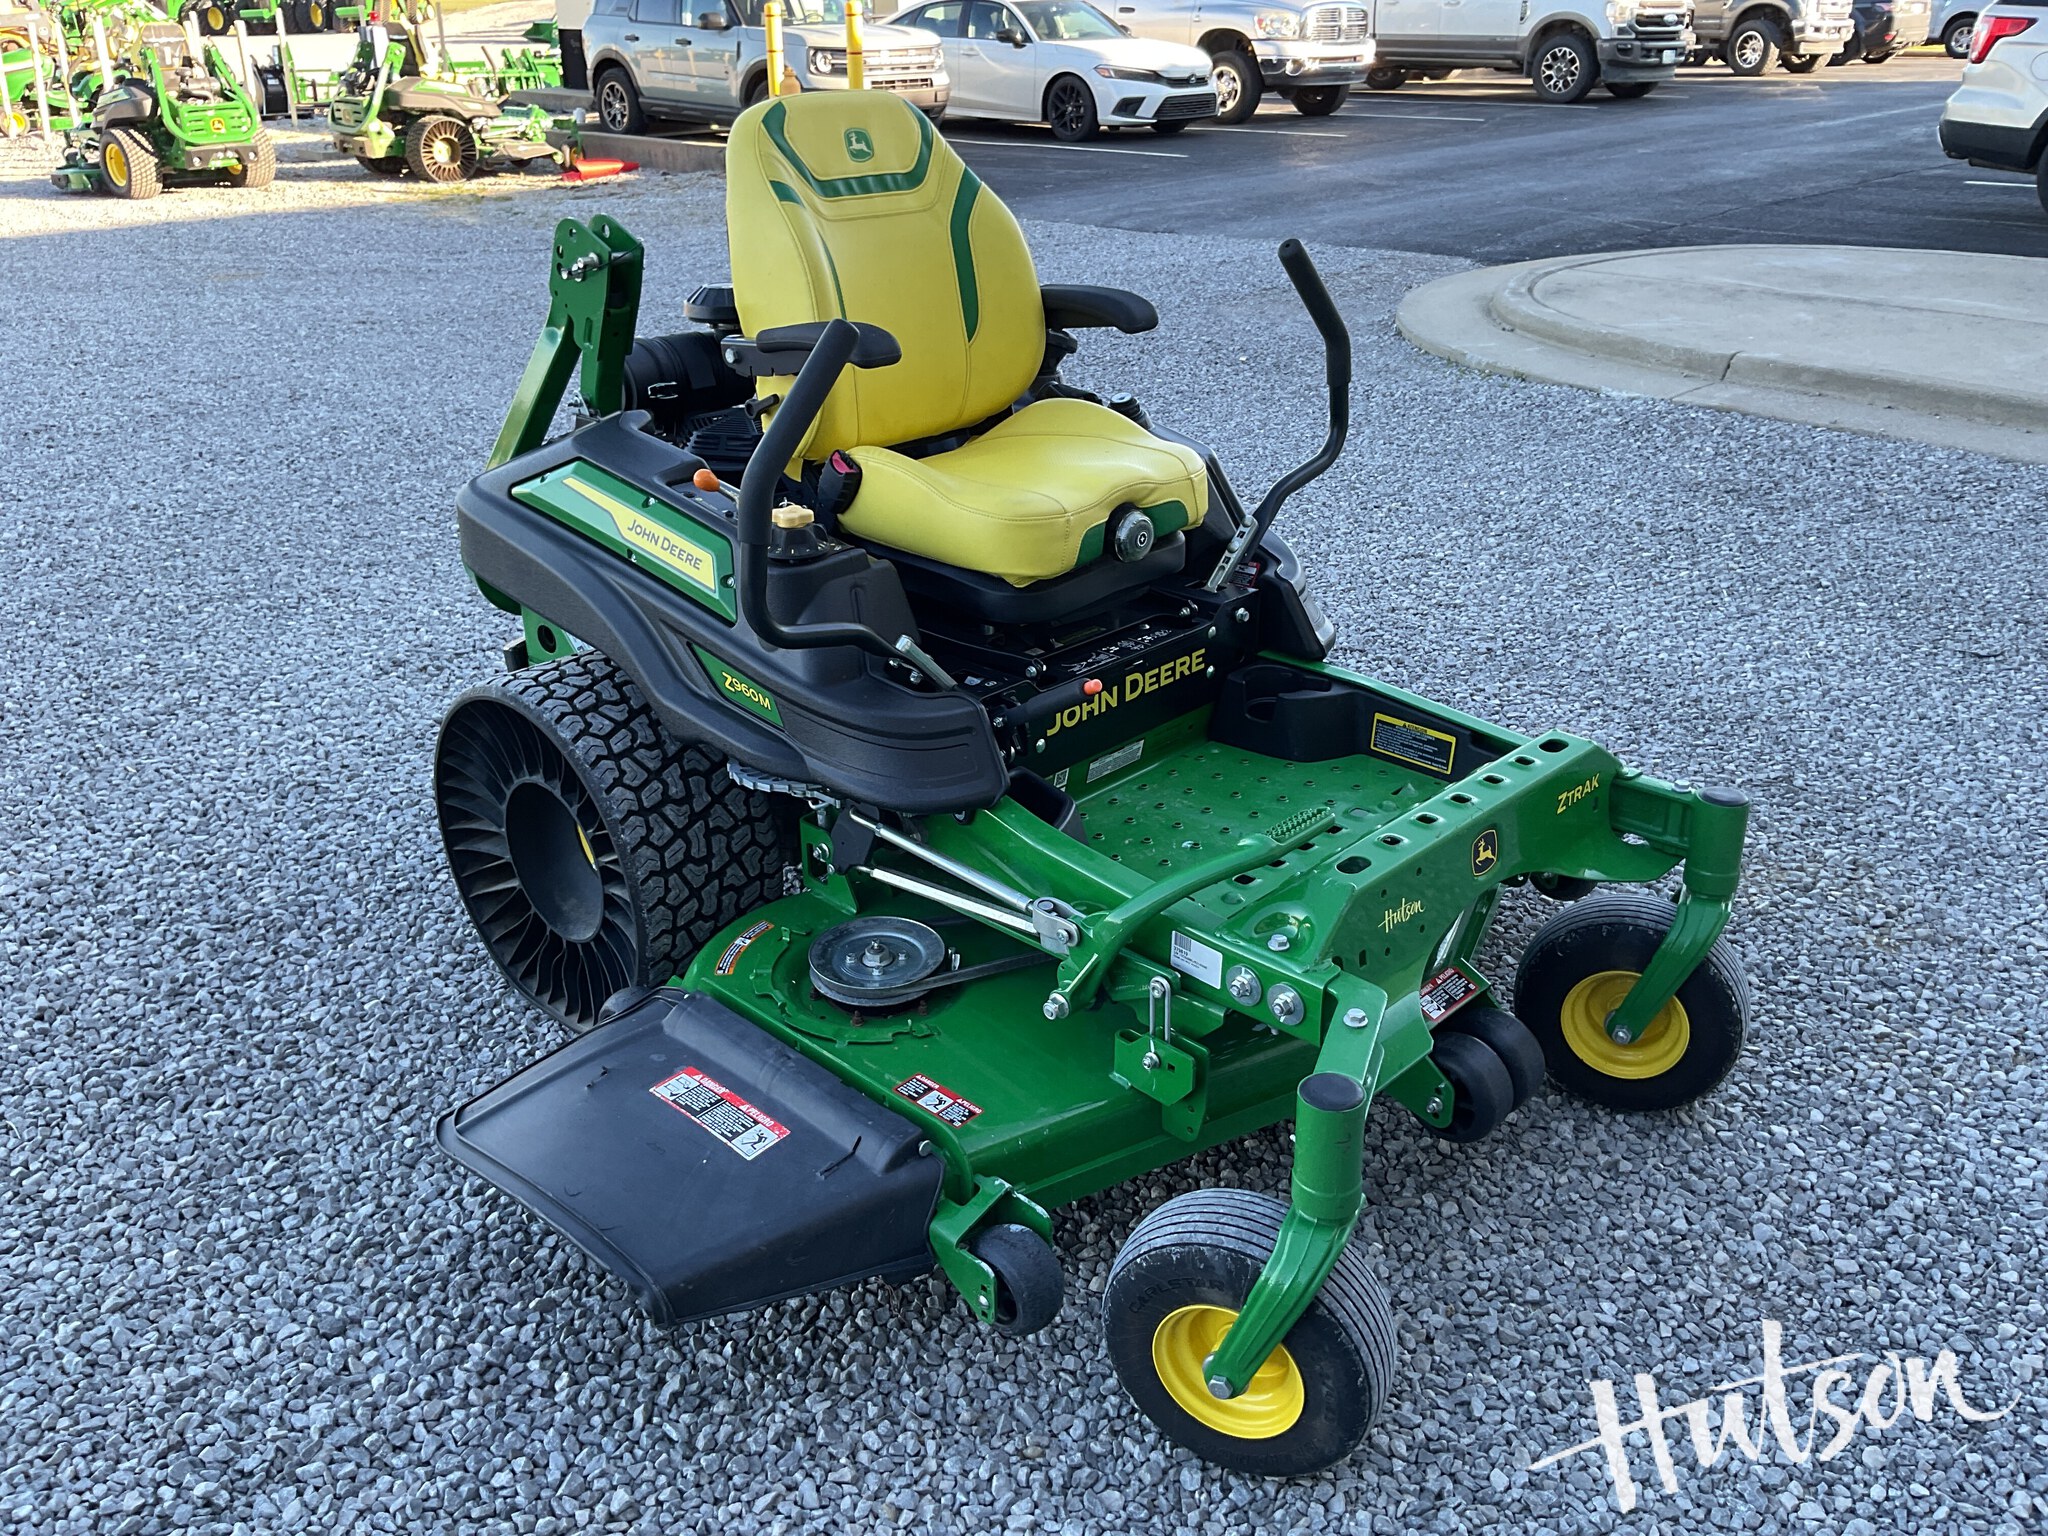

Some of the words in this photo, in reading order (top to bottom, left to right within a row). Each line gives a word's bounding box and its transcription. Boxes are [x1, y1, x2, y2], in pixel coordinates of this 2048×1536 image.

[627, 519, 660, 546] JOHN
[660, 536, 702, 571] DEERE
[722, 672, 771, 710] Z960M
[1046, 685, 1118, 737] JOHN
[1125, 648, 1206, 702] DEERE
[1557, 773, 1600, 814] ZTRAK
[1378, 897, 1427, 933] Hutson
[745, 1104, 775, 1127] PELIGRO
